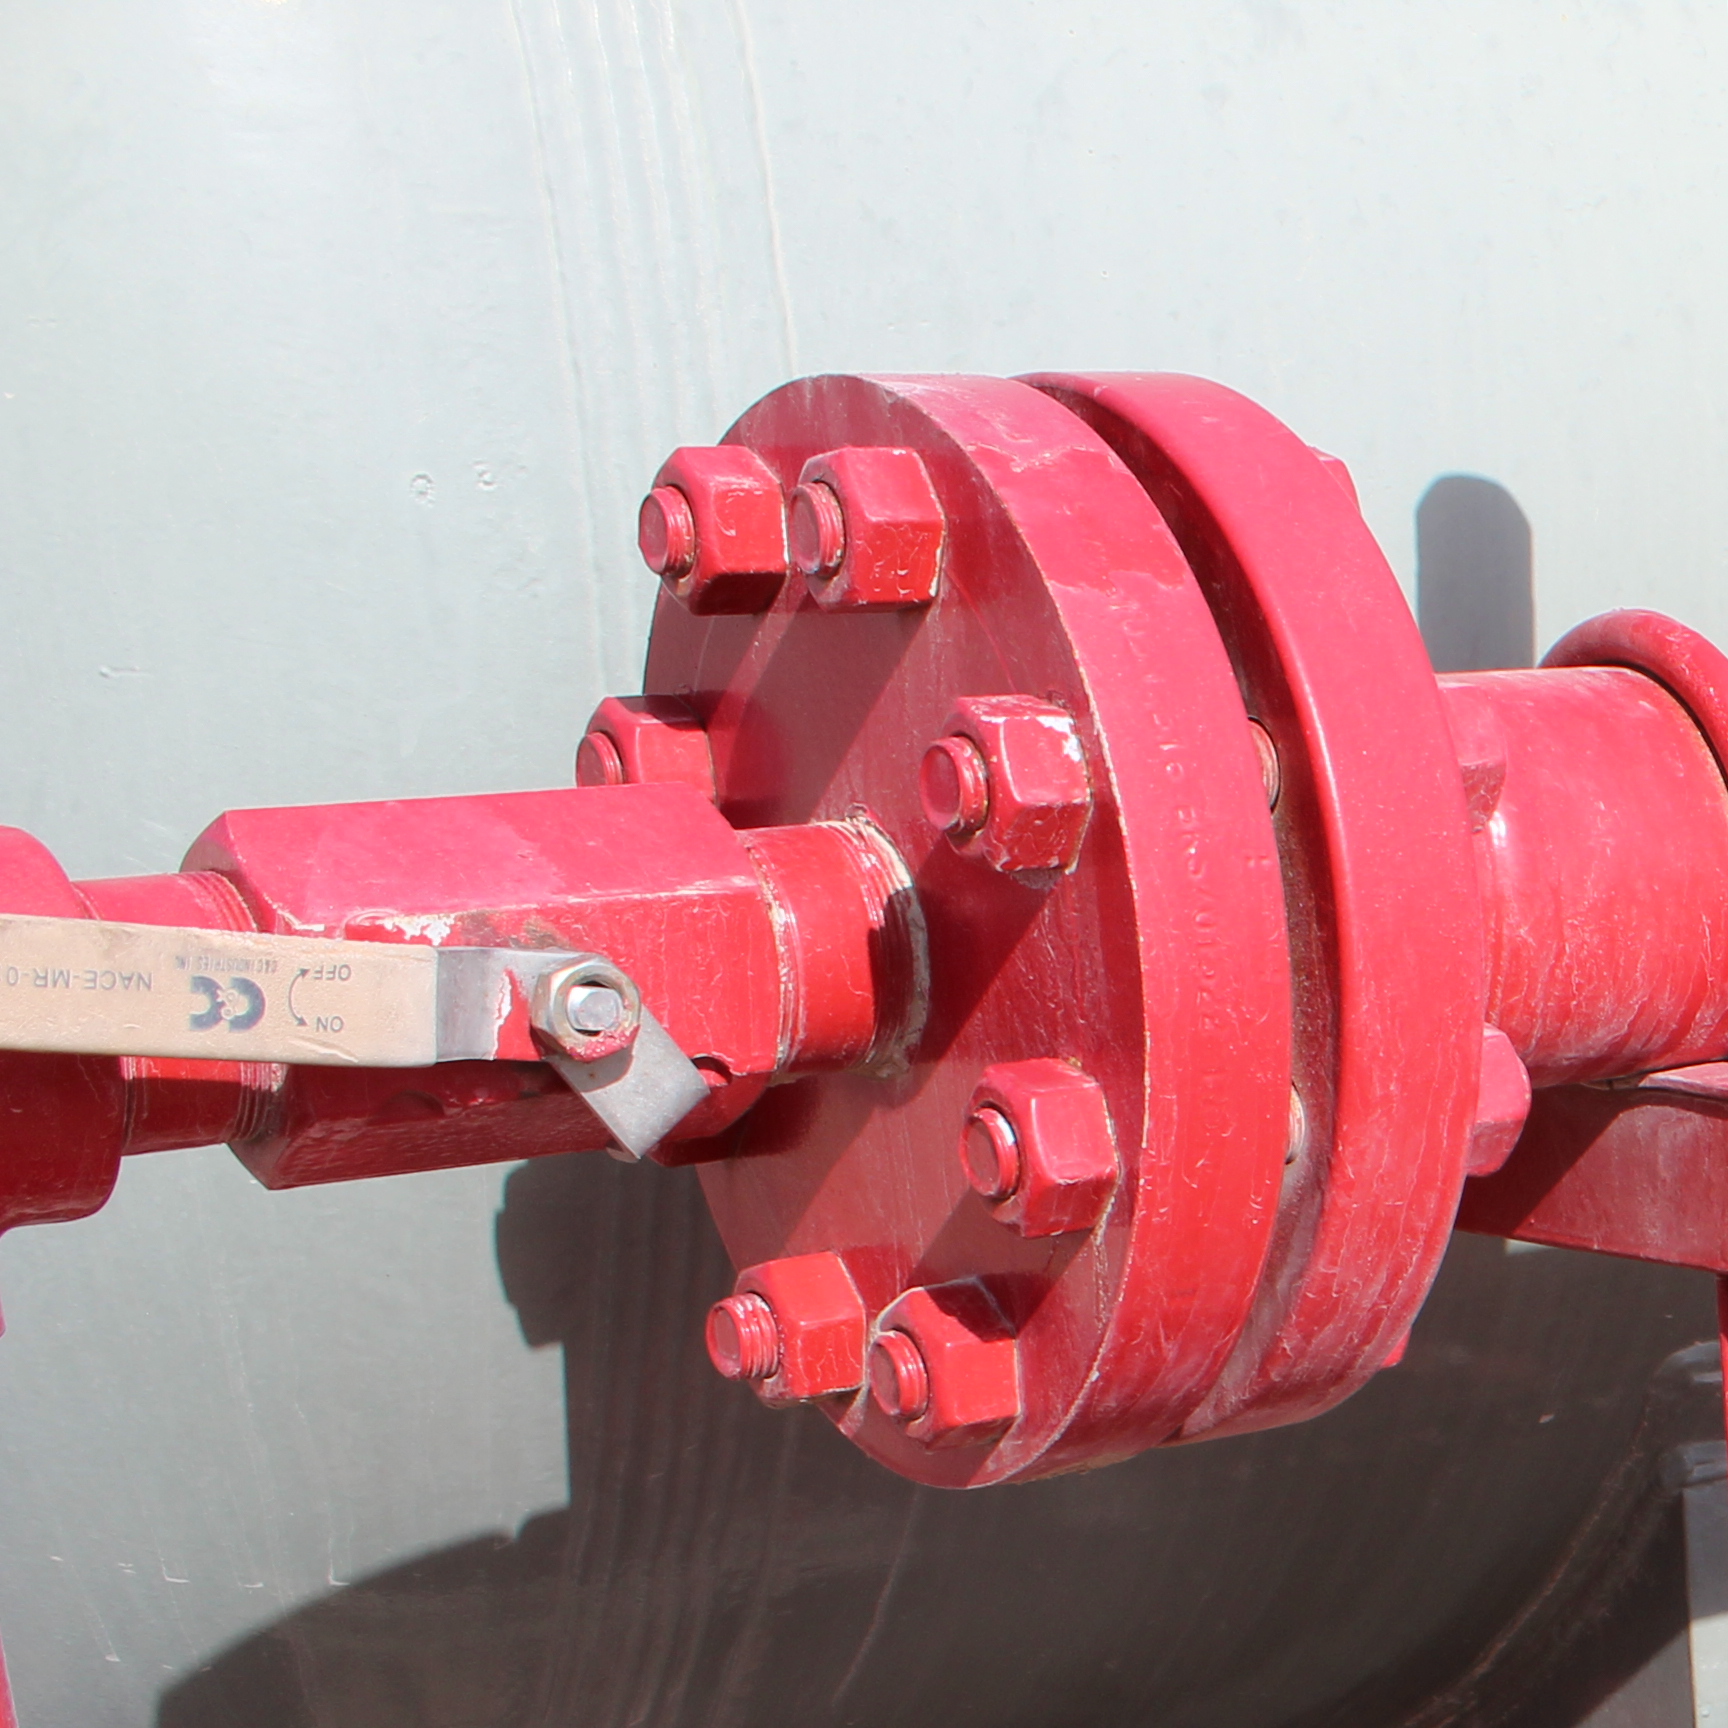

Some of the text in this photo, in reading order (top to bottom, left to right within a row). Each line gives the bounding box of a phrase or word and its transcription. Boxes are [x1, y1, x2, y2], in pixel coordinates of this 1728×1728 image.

[0, 965, 153, 992] NACE-MR-0
[314, 963, 352, 981] OFF
[316, 1016, 344, 1033] ON
